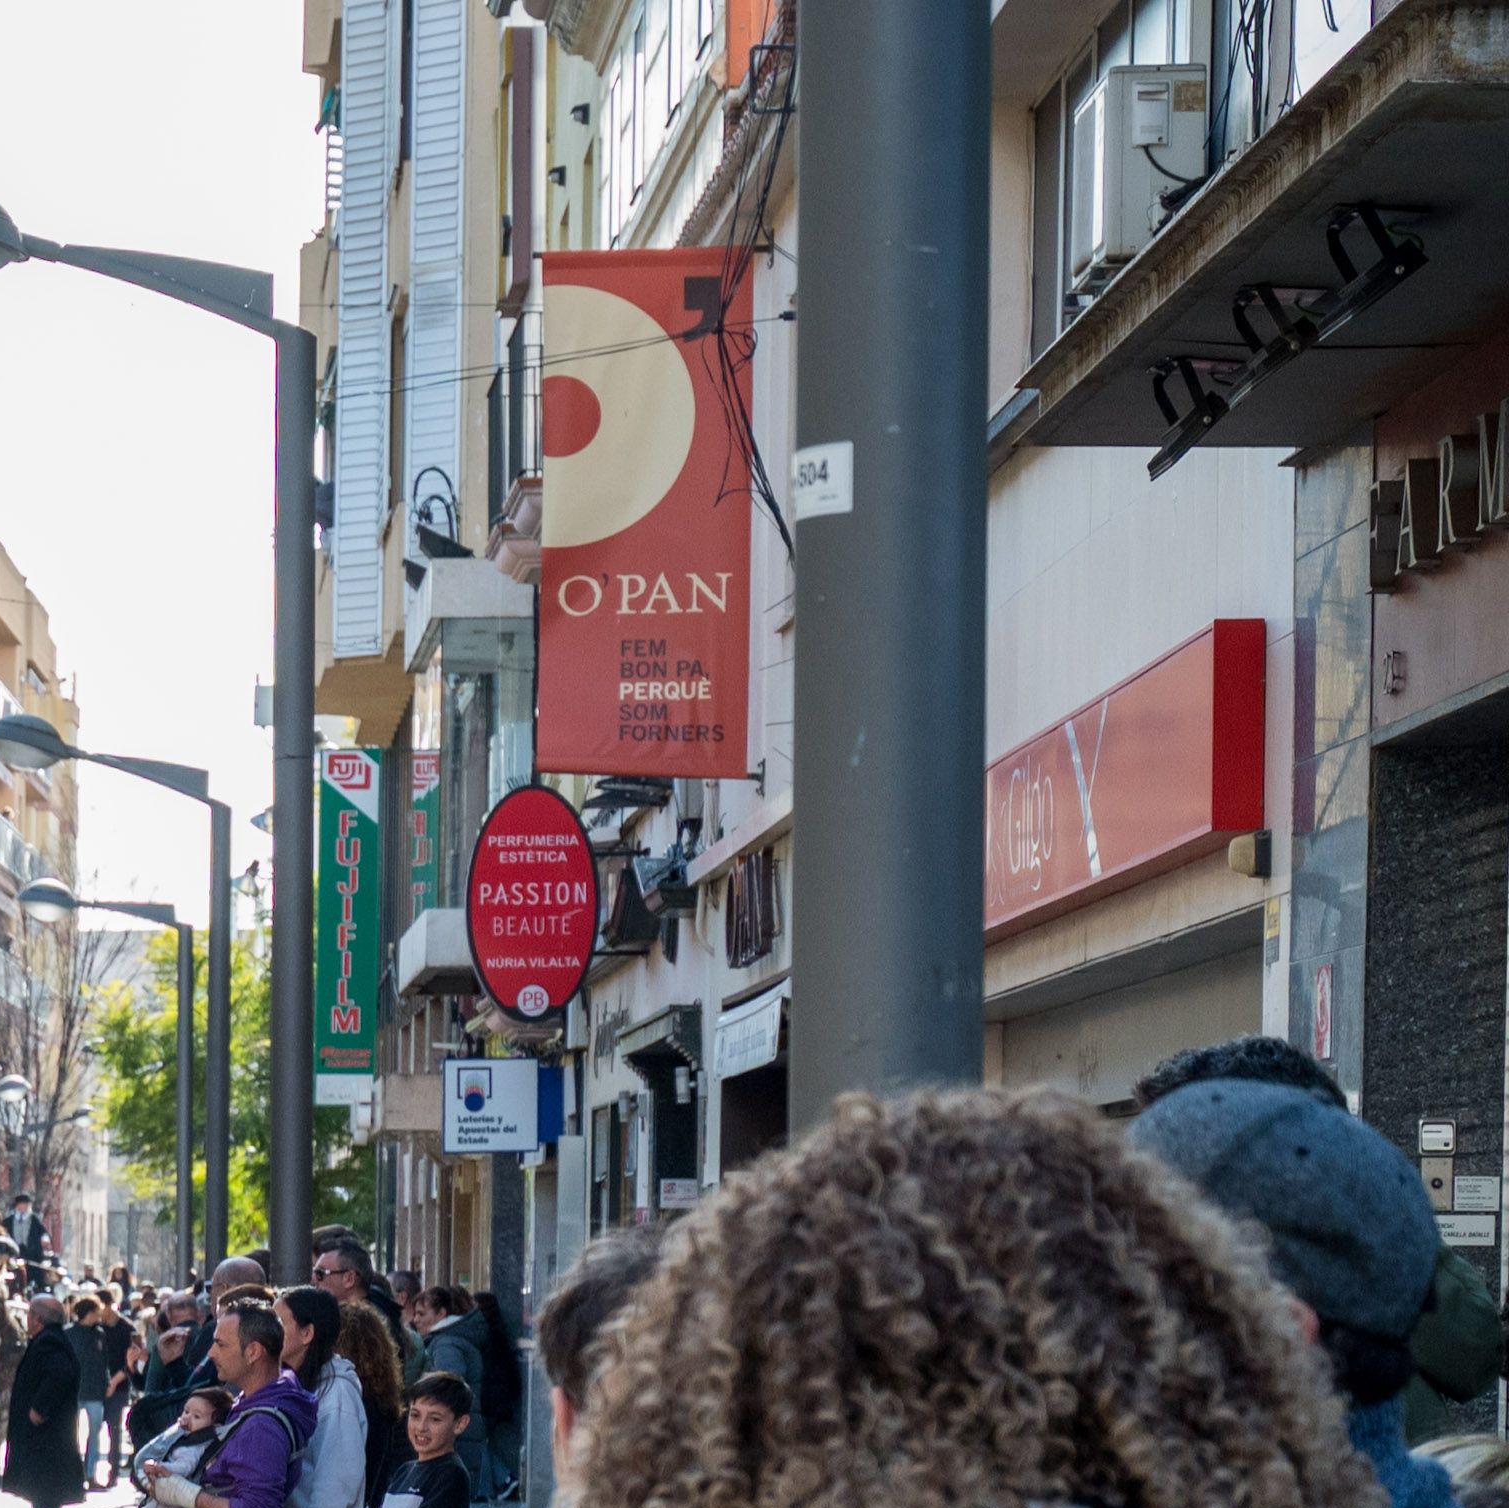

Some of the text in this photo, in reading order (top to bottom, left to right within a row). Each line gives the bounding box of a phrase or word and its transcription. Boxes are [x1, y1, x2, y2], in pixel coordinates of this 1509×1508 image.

[558, 572, 733, 616] O'PAN
[621, 640, 666, 657] FEM
[619, 660, 668, 678] BON
[619, 674, 712, 700] PERQUÈ
[619, 703, 668, 721] SOM
[618, 724, 725, 743] FORNERS
[488, 834, 579, 847] PERFUMERIA
[480, 881, 587, 906] PASSION
[330, 810, 362, 1034] FUJIFILM
[486, 956, 580, 968] NÚRIA VILALTA
[522, 992, 545, 1009] PB
[458, 1126, 500, 1134] Apuestas
